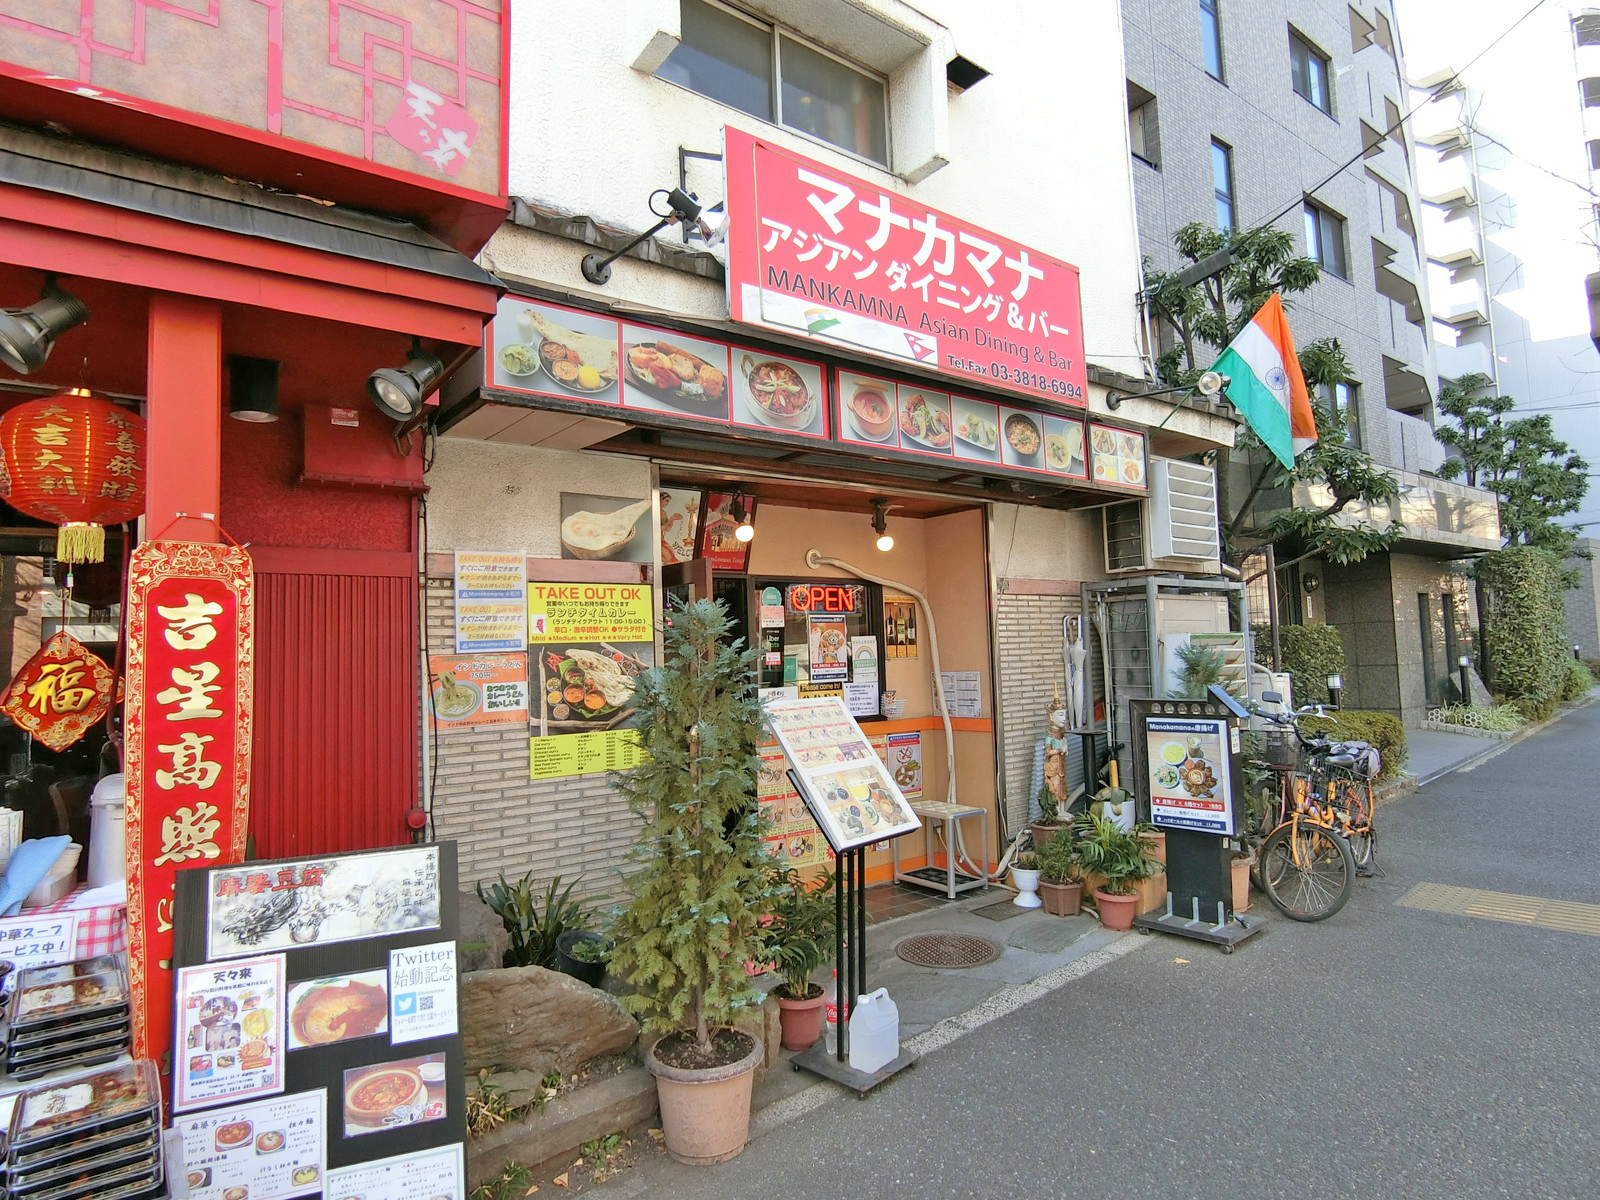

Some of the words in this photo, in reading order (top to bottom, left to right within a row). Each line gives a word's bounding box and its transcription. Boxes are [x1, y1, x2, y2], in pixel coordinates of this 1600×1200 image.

[797, 167, 1045, 301] マナカマナ
[761, 217, 878, 280] アジアン
[885, 262, 1069, 339] ダイニング&バー
[767, 266, 909, 325] MANKAMNA
[919, 312, 970, 342] Asian
[975, 329, 1030, 364] Dining
[1033, 345, 1047, 364] &
[1049, 349, 1073, 372] Bar
[947, 354, 988, 377] Tel.Fax
[990, 361, 1084, 400] 03-3818-6994
[535, 587, 580, 600] TAKE
[584, 587, 616, 600] OUT
[620, 588, 641, 600] OK
[791, 586, 855, 612] OPEN
[546, 608, 636, 618] ランチタイムカレー
[28, 659, 96, 714] 福
[487, 691, 524, 700] カレーうどん
[216, 866, 326, 898] 麻婆豆腐
[413, 868, 425, 907] 伝承の味
[425, 852, 437, 902] 本場四川省
[392, 950, 454, 968] Twitter
[213, 967, 253, 984] 天々来
[394, 962, 454, 989] 始動記念
